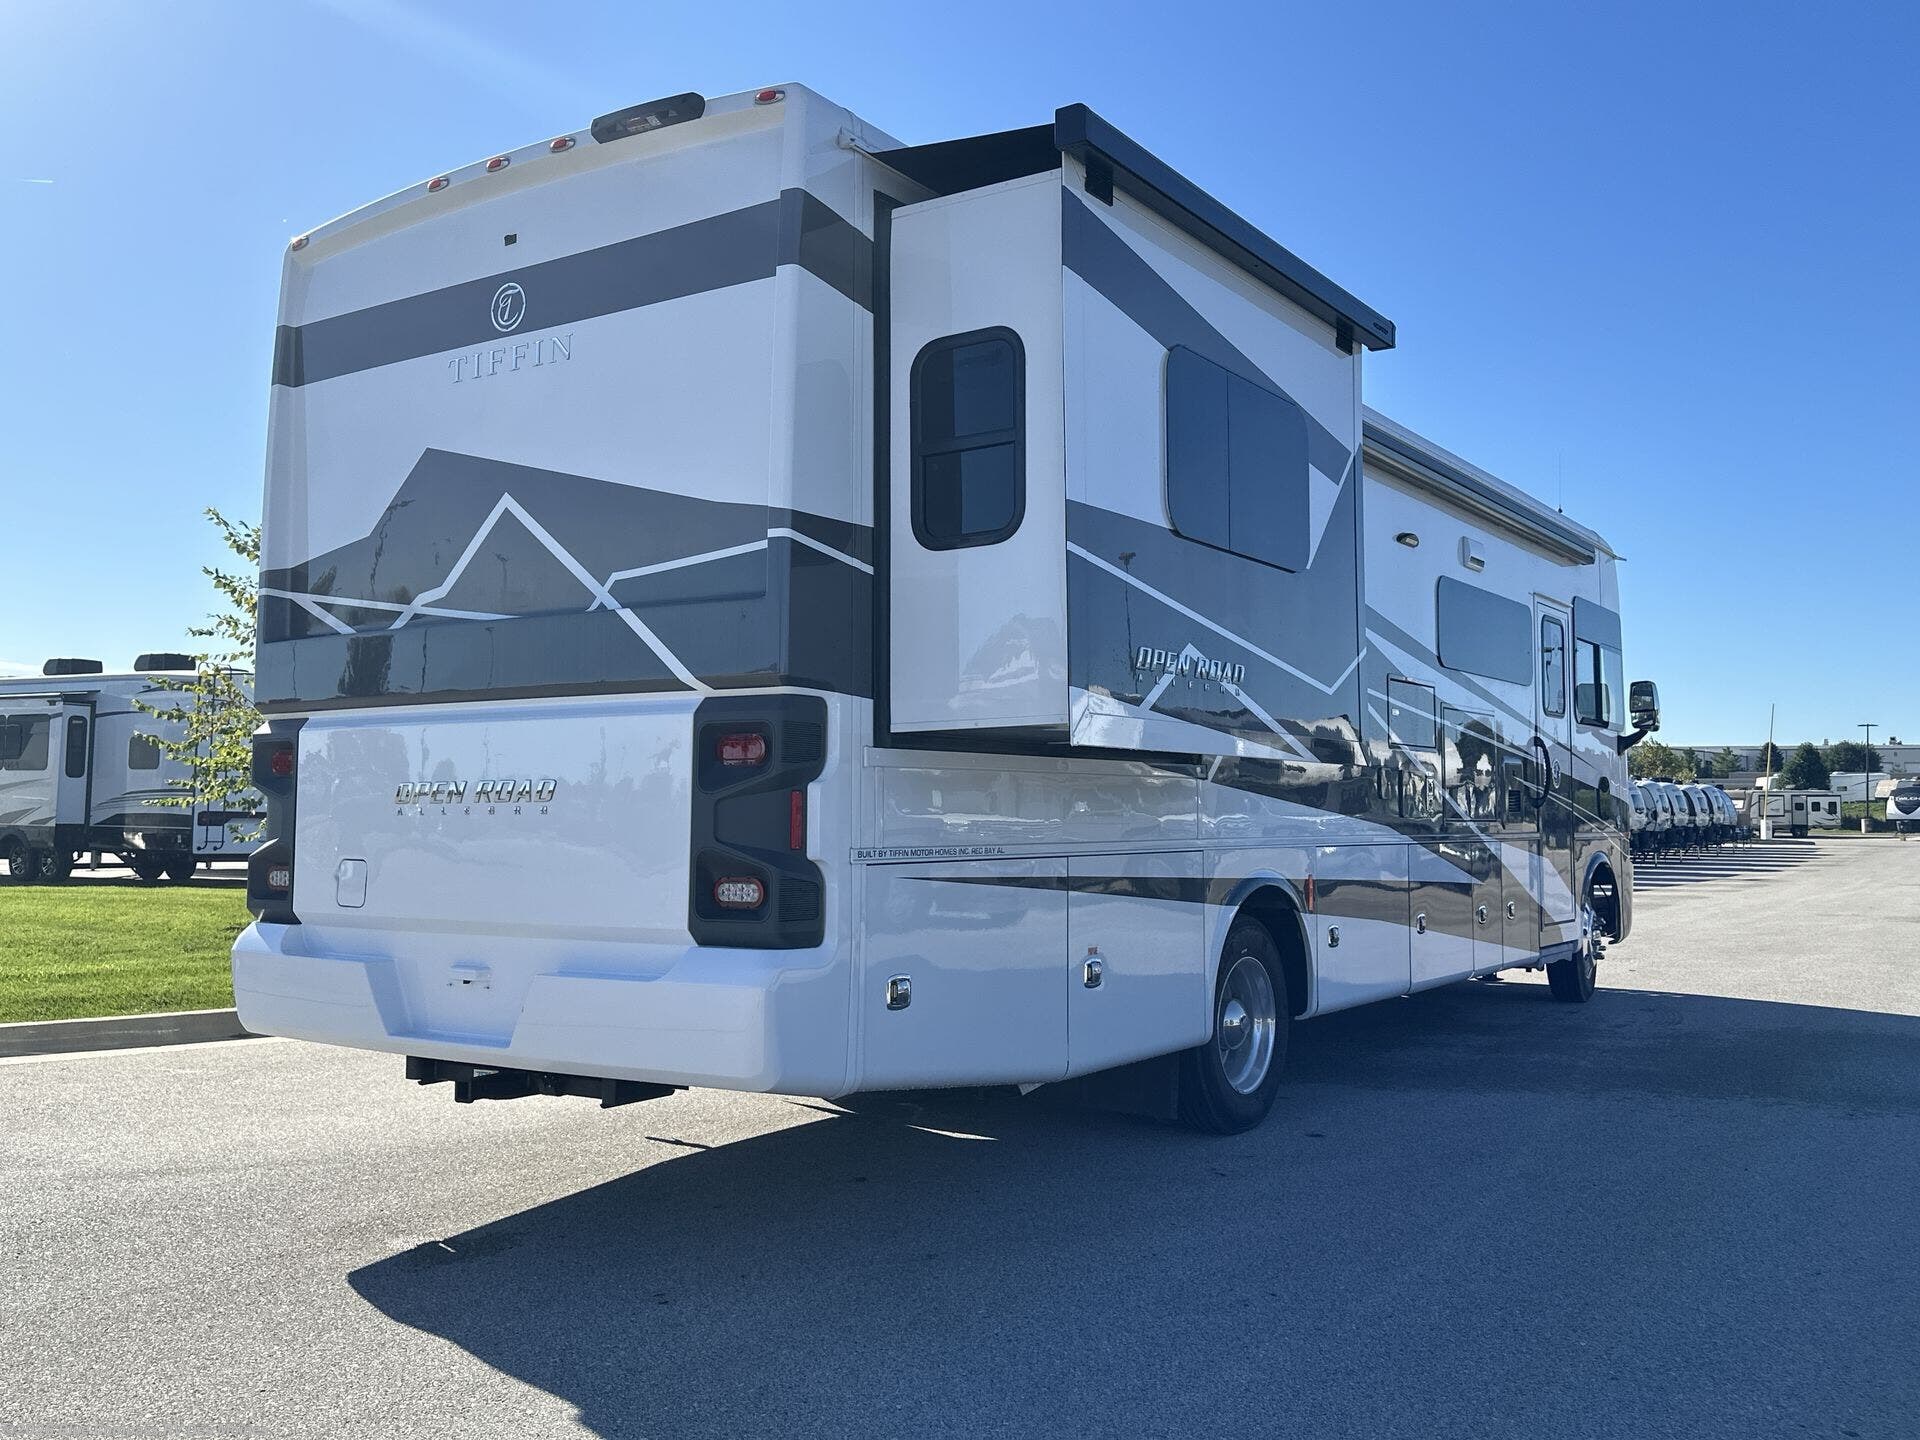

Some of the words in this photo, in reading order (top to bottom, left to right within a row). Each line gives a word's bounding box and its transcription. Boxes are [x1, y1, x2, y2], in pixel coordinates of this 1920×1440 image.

[448, 333, 575, 384] TIFFIN
[1135, 646, 1191, 675] OPEN
[1194, 657, 1246, 684] ROAD
[394, 779, 468, 804] OPEN
[474, 778, 558, 803] ROAD
[396, 806, 548, 816] ALLEGRO
[857, 850, 877, 858] BUILT
[878, 850, 888, 858] BY
[889, 849, 909, 857] TIFFIN
[910, 848, 934, 857] MOTOR
[934, 847, 957, 856] HOMES
[984, 847, 996, 855] BAY
